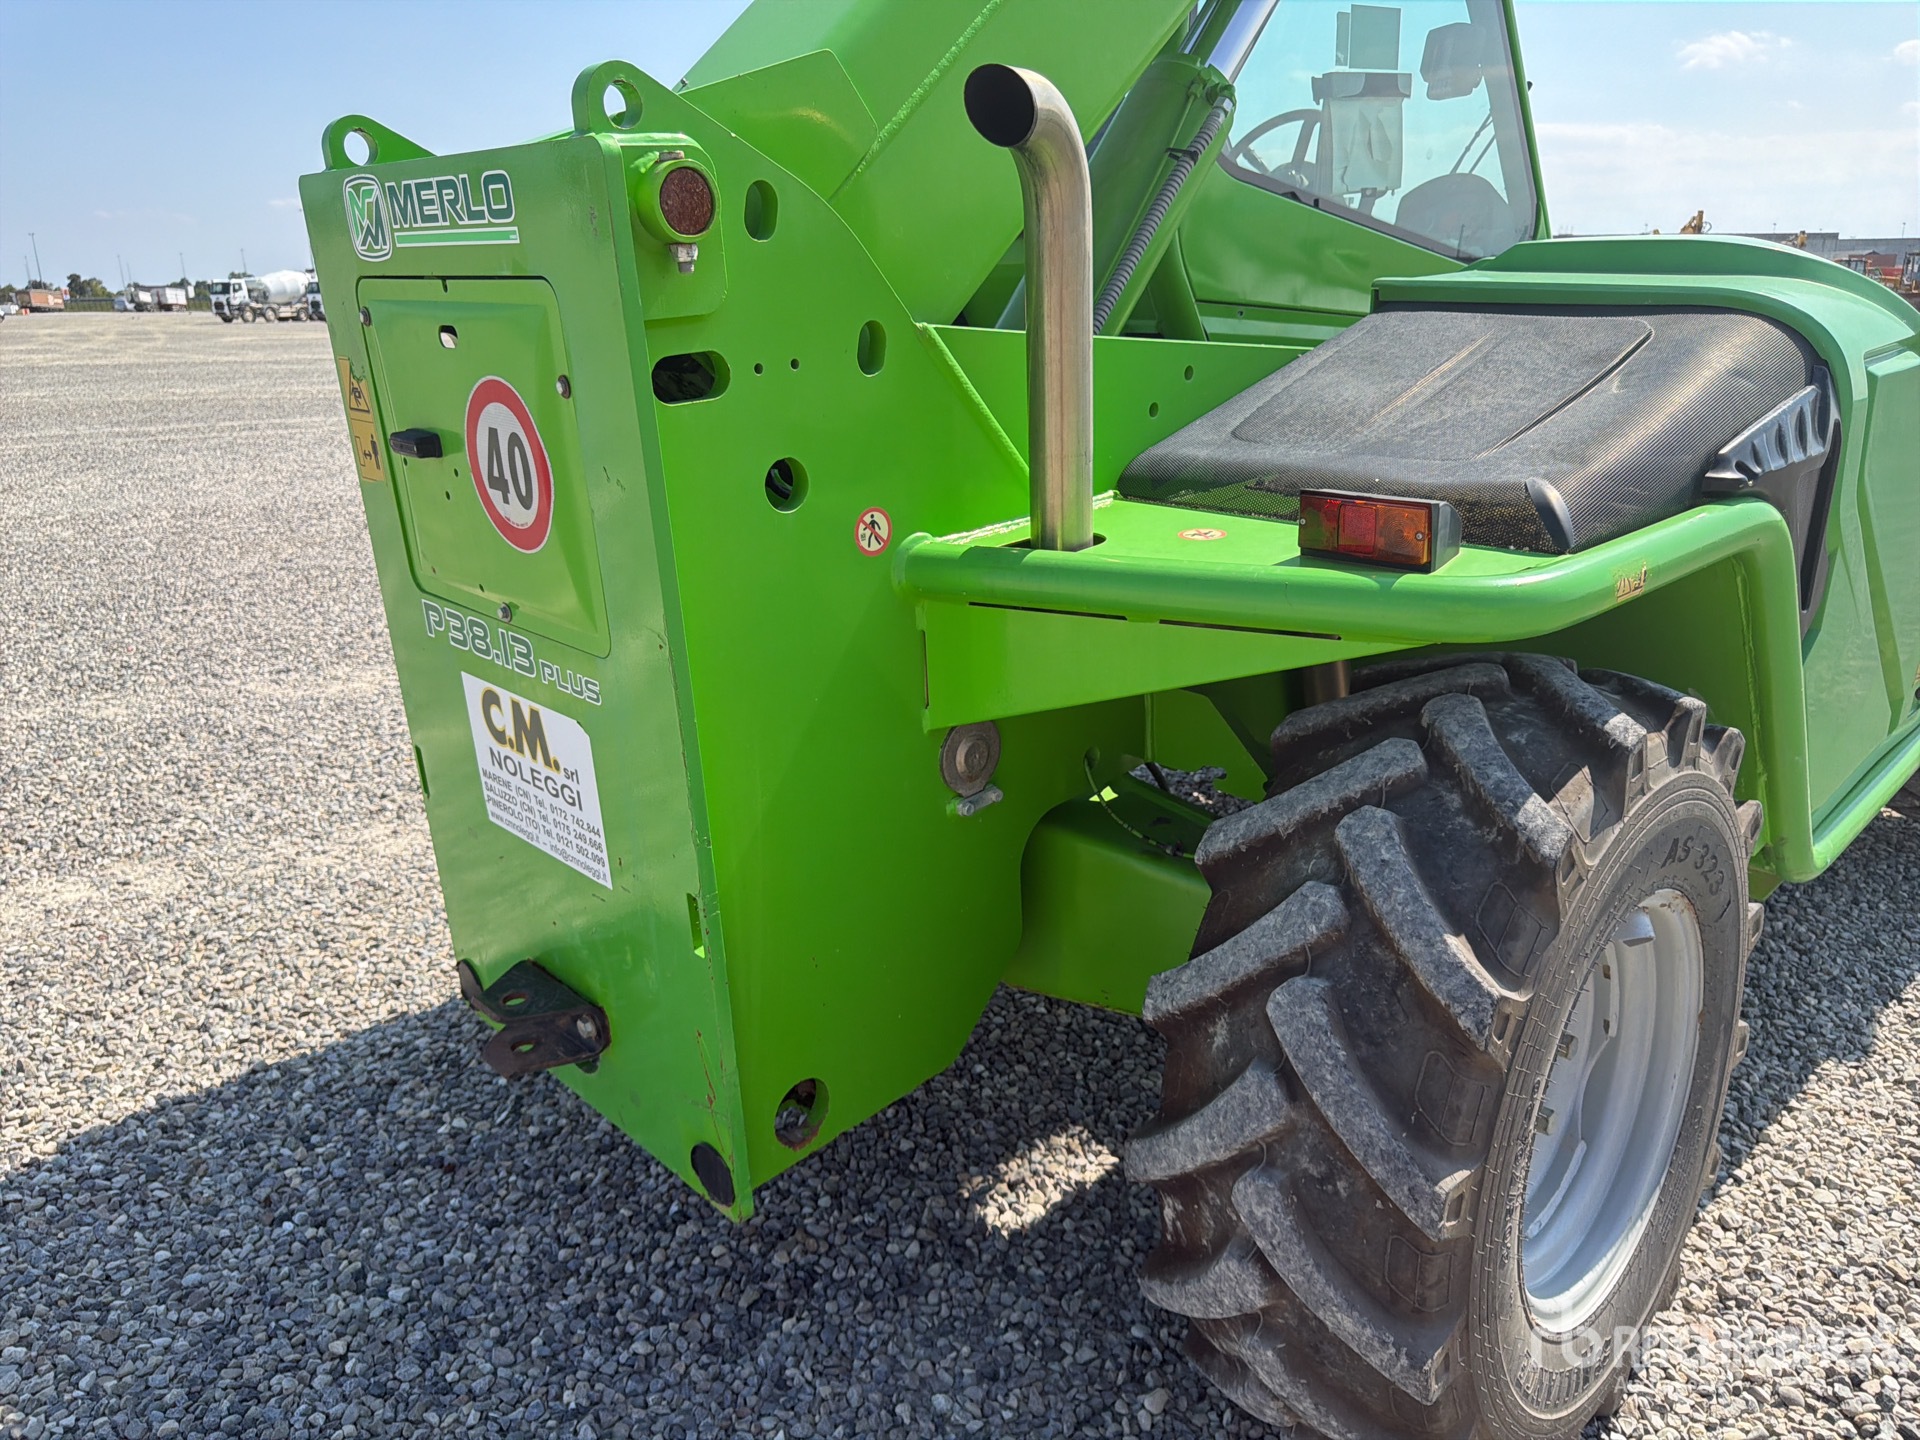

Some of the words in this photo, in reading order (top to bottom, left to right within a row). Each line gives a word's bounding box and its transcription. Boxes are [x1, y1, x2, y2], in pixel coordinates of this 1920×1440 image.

[385, 169, 516, 228] MERLO
[487, 426, 534, 511] 40
[421, 598, 537, 678] P38.13
[539, 659, 602, 706] PLUS
[481, 686, 561, 774] C.M.
[563, 766, 580, 785] srl
[489, 747, 583, 812] NOLEGGI
[549, 803, 568, 821] 0172
[552, 817, 571, 836] 0175
[555, 832, 574, 851] 0121
[1660, 835, 1694, 869] AS
[1694, 843, 1725, 896] 323
